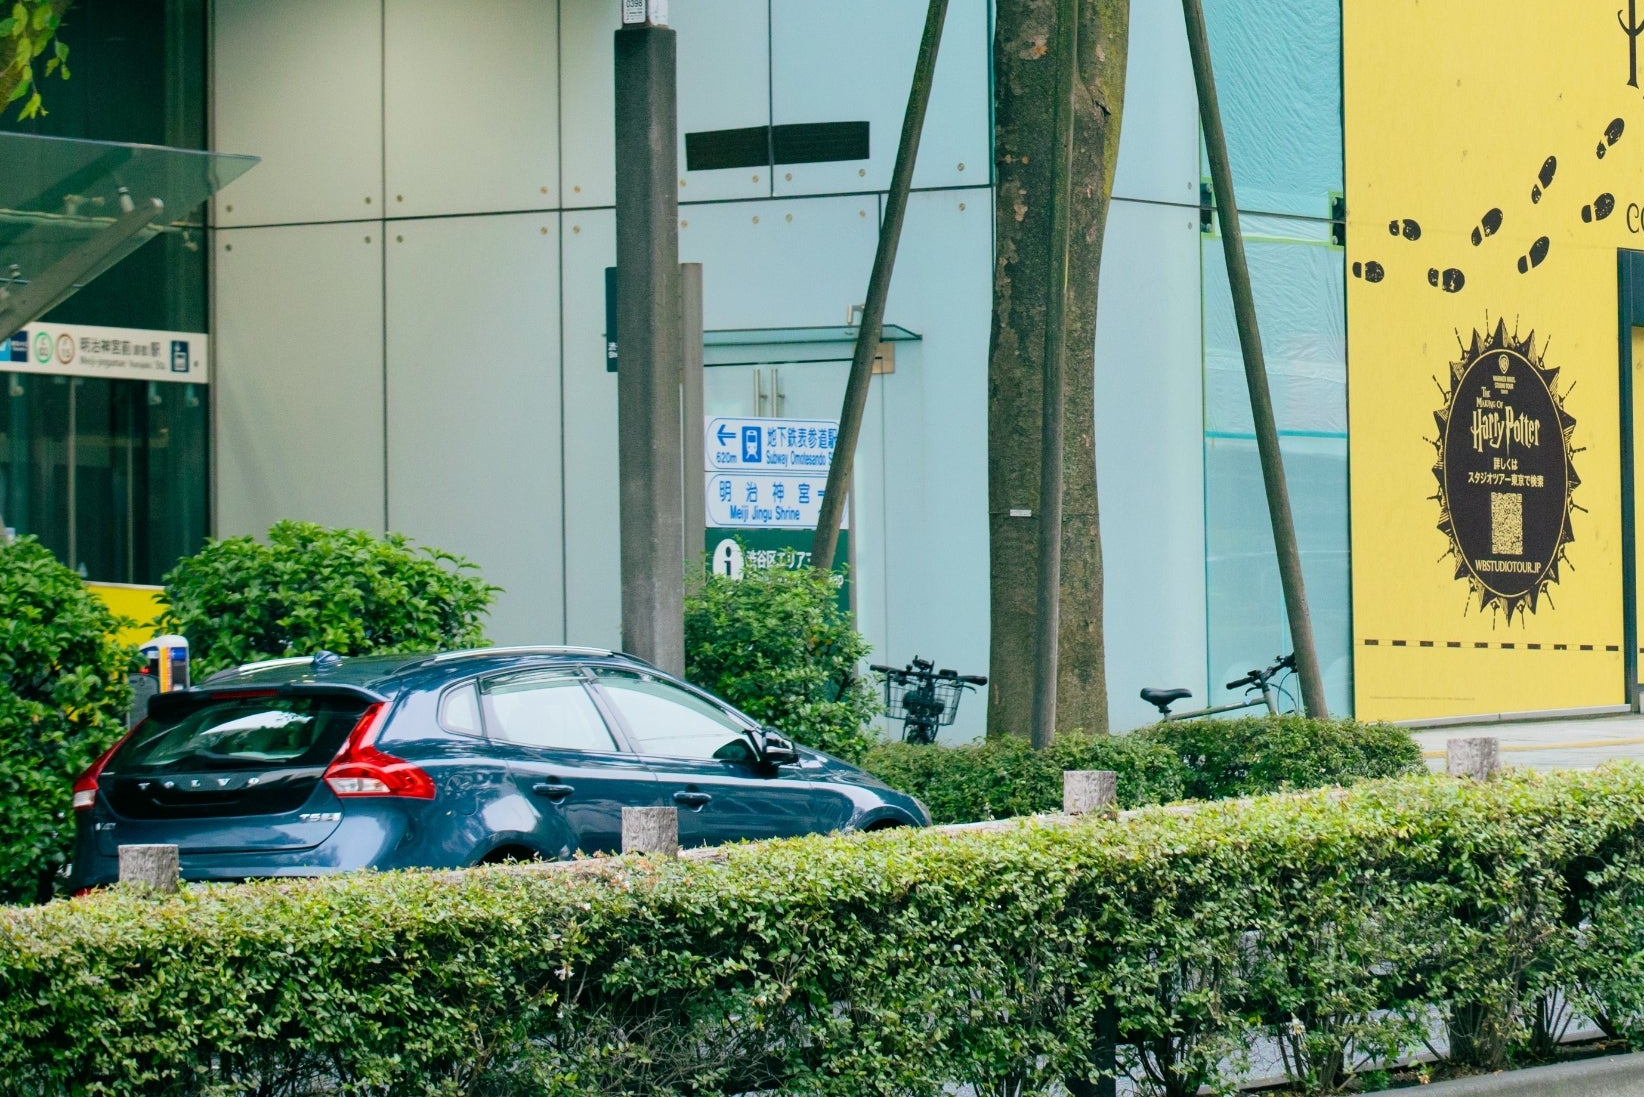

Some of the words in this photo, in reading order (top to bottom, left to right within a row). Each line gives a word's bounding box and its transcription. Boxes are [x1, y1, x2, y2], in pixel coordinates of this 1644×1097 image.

[767, 426, 837, 449] 地下鉄表参道駅
[1470, 408, 1505, 453] Harry
[1505, 405, 1541, 457] Potter
[766, 450, 789, 467] Subway
[790, 451, 826, 466] Omotesando
[1493, 456, 1519, 471] 詳しくは
[1467, 471, 1544, 488] スタジオツアー東京で検索
[729, 505, 749, 523] Meiji
[752, 506, 773, 522] Jingu
[775, 507, 800, 521] Shrine
[1474, 559, 1541, 574] WBSTUDIOTOUR.JP
[137, 777, 260, 791] VOLVO
